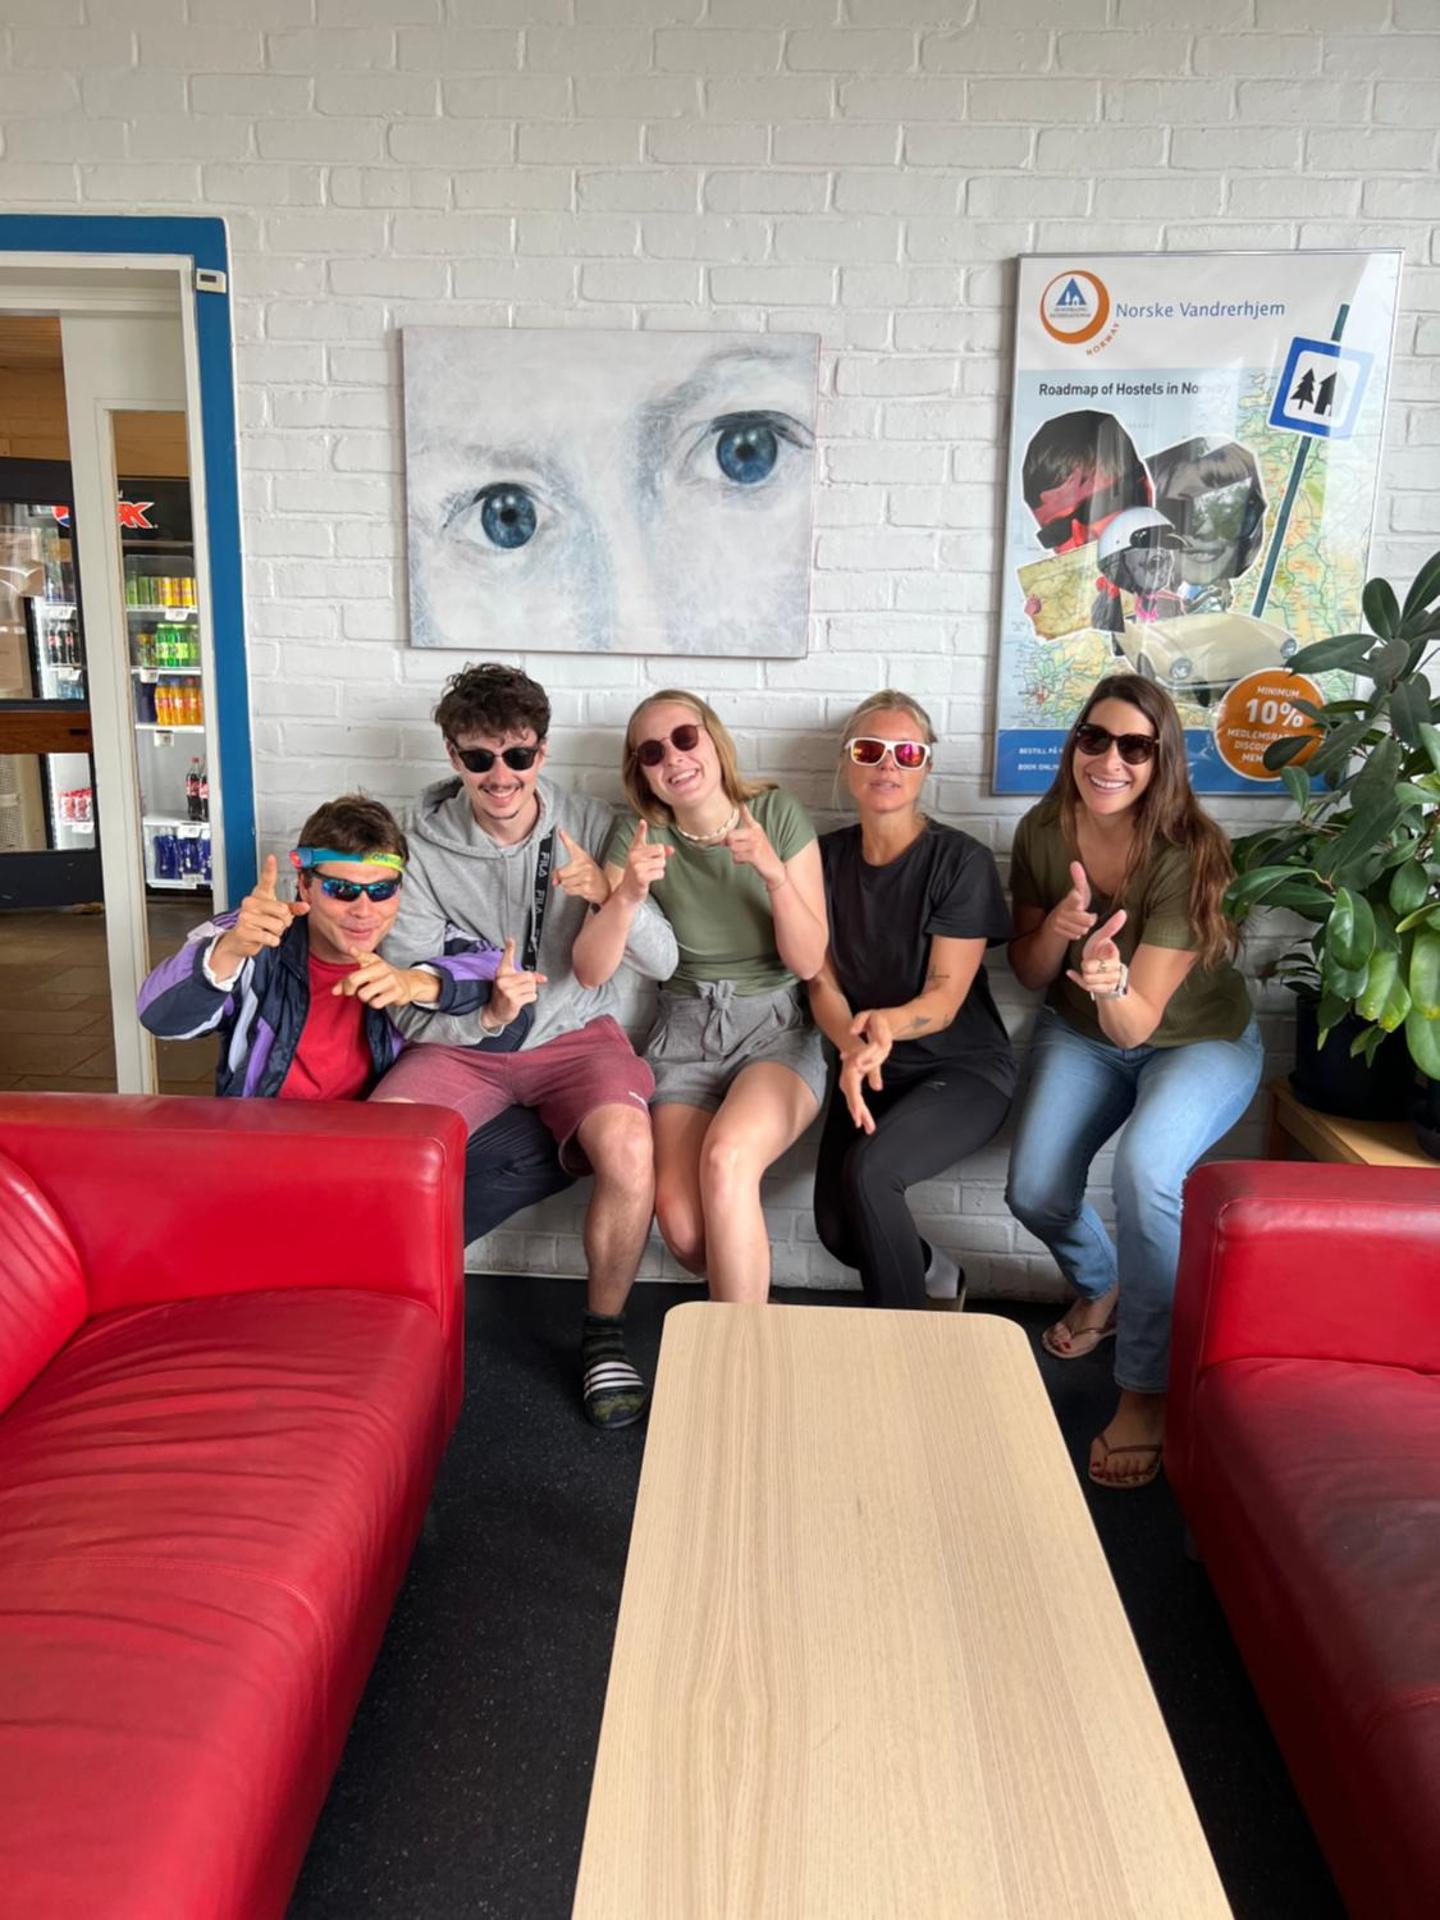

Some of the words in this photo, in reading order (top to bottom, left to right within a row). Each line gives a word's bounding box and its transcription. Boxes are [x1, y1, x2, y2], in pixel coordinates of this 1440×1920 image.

[1116, 302, 1174, 318] Norske
[1180, 301, 1285, 319] Vandrerhjem
[1039, 383, 1098, 397] Roadmap
[1101, 383, 1113, 395] of
[1116, 383, 1164, 395] Hostels
[1166, 383, 1178, 394] in
[1257, 686, 1300, 697] MINIMUM
[1245, 698, 1304, 728] 10%
[1241, 753, 1265, 763] MEM
[539, 852, 551, 878] FILA
[535, 889, 546, 914] FILA
